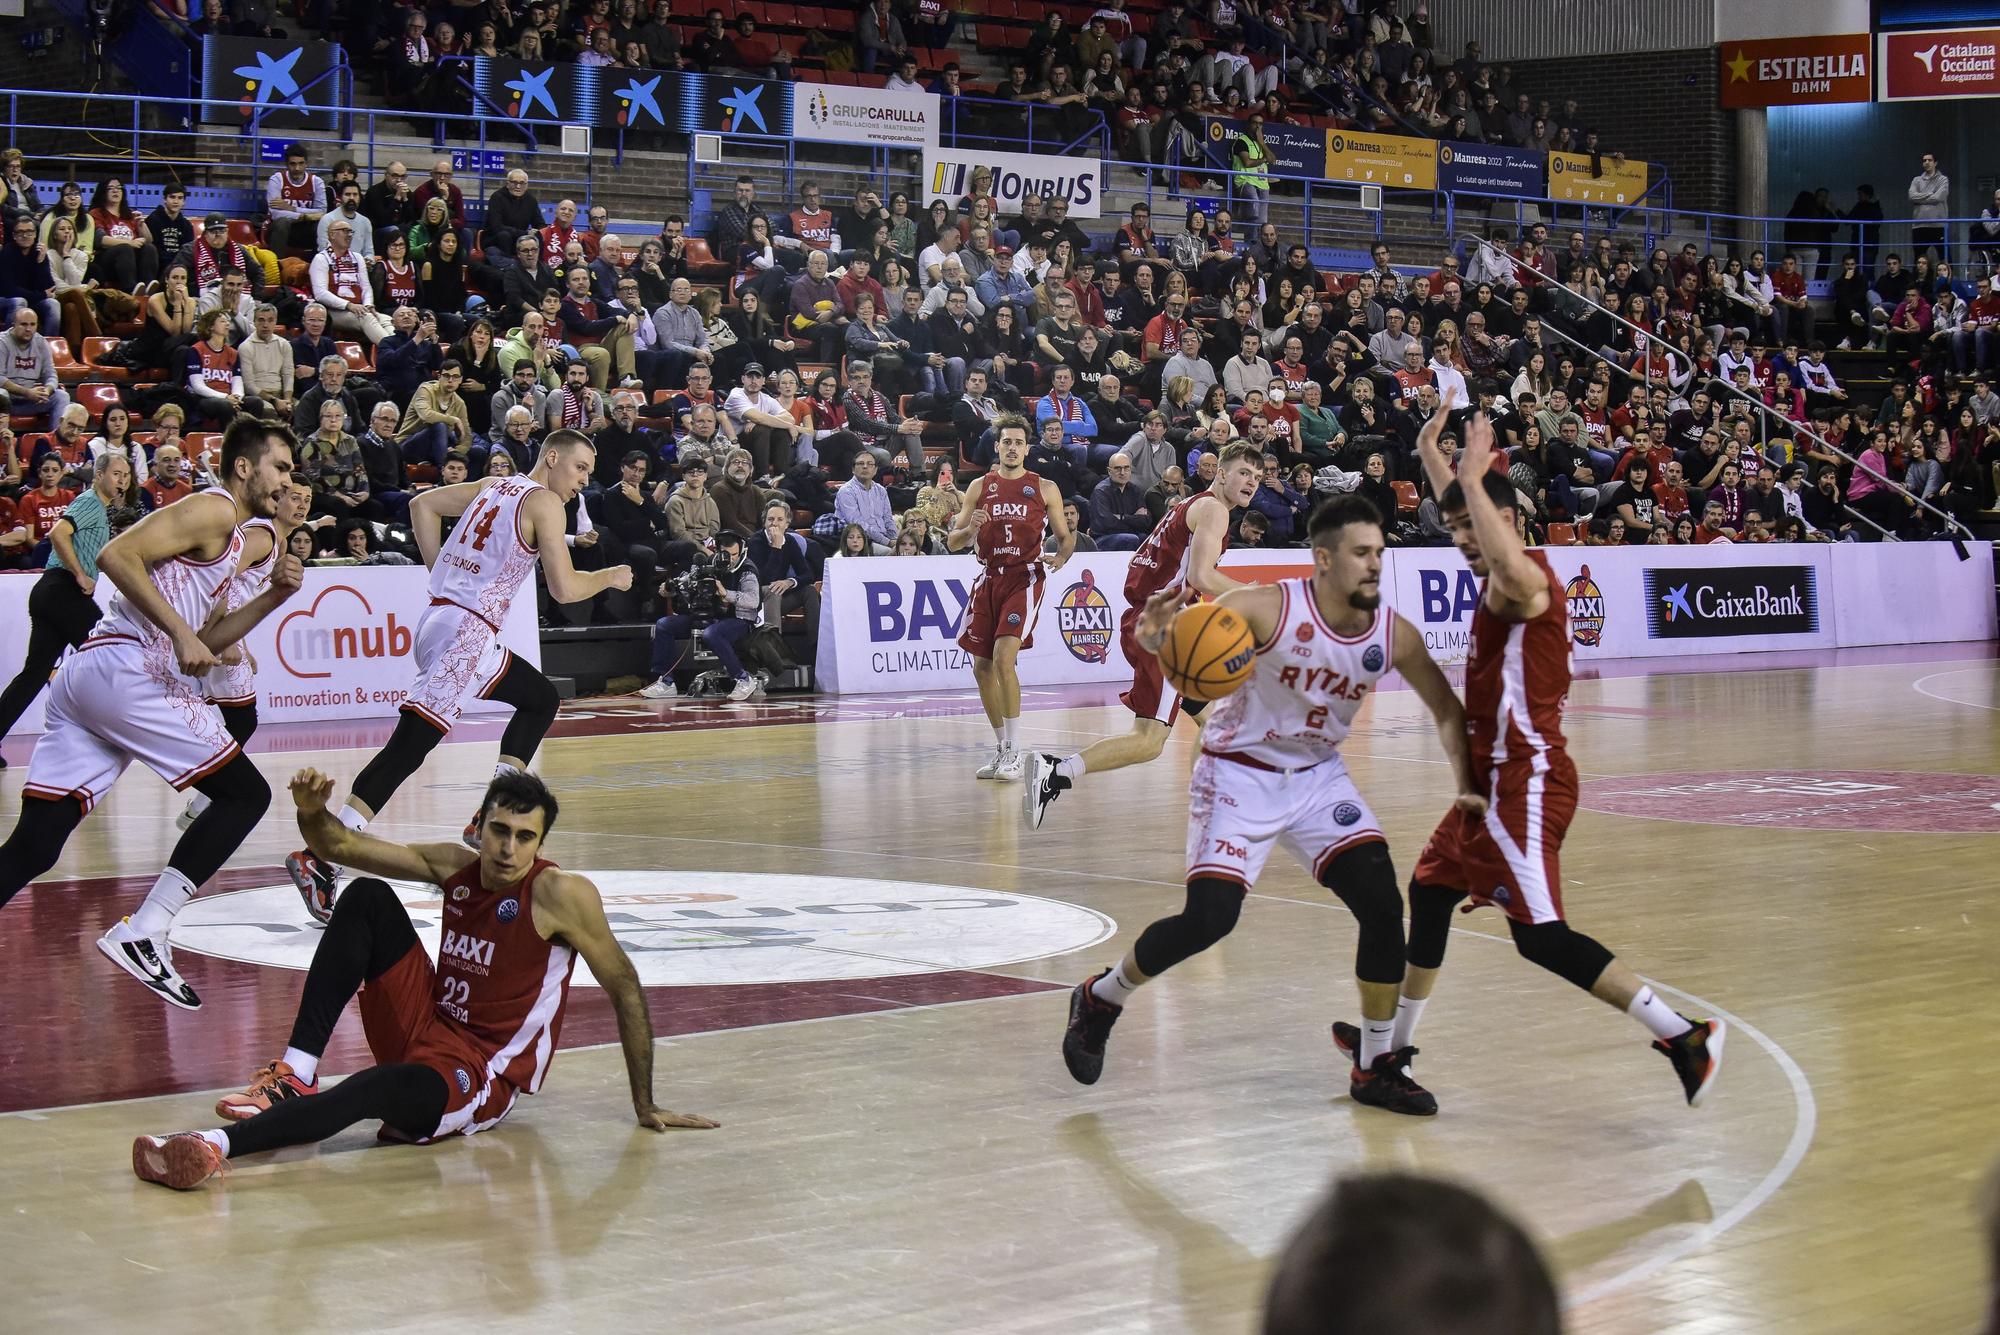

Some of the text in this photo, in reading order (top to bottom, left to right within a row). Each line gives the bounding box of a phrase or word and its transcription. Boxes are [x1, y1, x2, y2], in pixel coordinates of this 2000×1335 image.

[1940, 43, 1995, 58] Catalana
[1759, 54, 1866, 81] ESTRELLA
[1940, 57, 1995, 72] Occident
[1792, 80, 1831, 93] DAMM
[1941, 72, 1995, 83] Assegurances
[832, 104, 925, 124] GRUPCARULLA
[883, 123, 926, 133] MANTENIMENT
[867, 133, 925, 144] www.grupcarulla.com
[1263, 134, 1280, 146] 2022
[1283, 133, 1322, 150] Transforma
[1346, 139, 1433, 160] Manresa 2022 Transforma
[455, 157, 463, 169] 4
[1275, 157, 1303, 169] ransforma
[1454, 152, 1539, 171] Manresa 2022 Transforma
[1456, 175, 1522, 189] La ciutat que (et) transforma
[391, 288, 415, 298] BAXI
[992, 503, 1028, 517] BAXI
[459, 497, 500, 552] 14
[1004, 524, 1013, 543] 5
[862, 579, 971, 642] BAX
[1566, 597, 1604, 618] BAXI
[1696, 584, 1804, 619] CaixaBank
[1058, 606, 1111, 632] BAXI
[1574, 620, 1600, 631] MANRESA
[294, 612, 412, 661] innub
[1072, 633, 1106, 646] MANRESA
[1424, 631, 1469, 650] CLIMA
[871, 649, 974, 675] CLIMATIZA
[1279, 665, 1368, 701] RYTAS
[268, 687, 408, 711] innovation & expe
[1306, 705, 1329, 730] 2
[442, 929, 496, 967] BAXI
[441, 976, 471, 1005] 22
